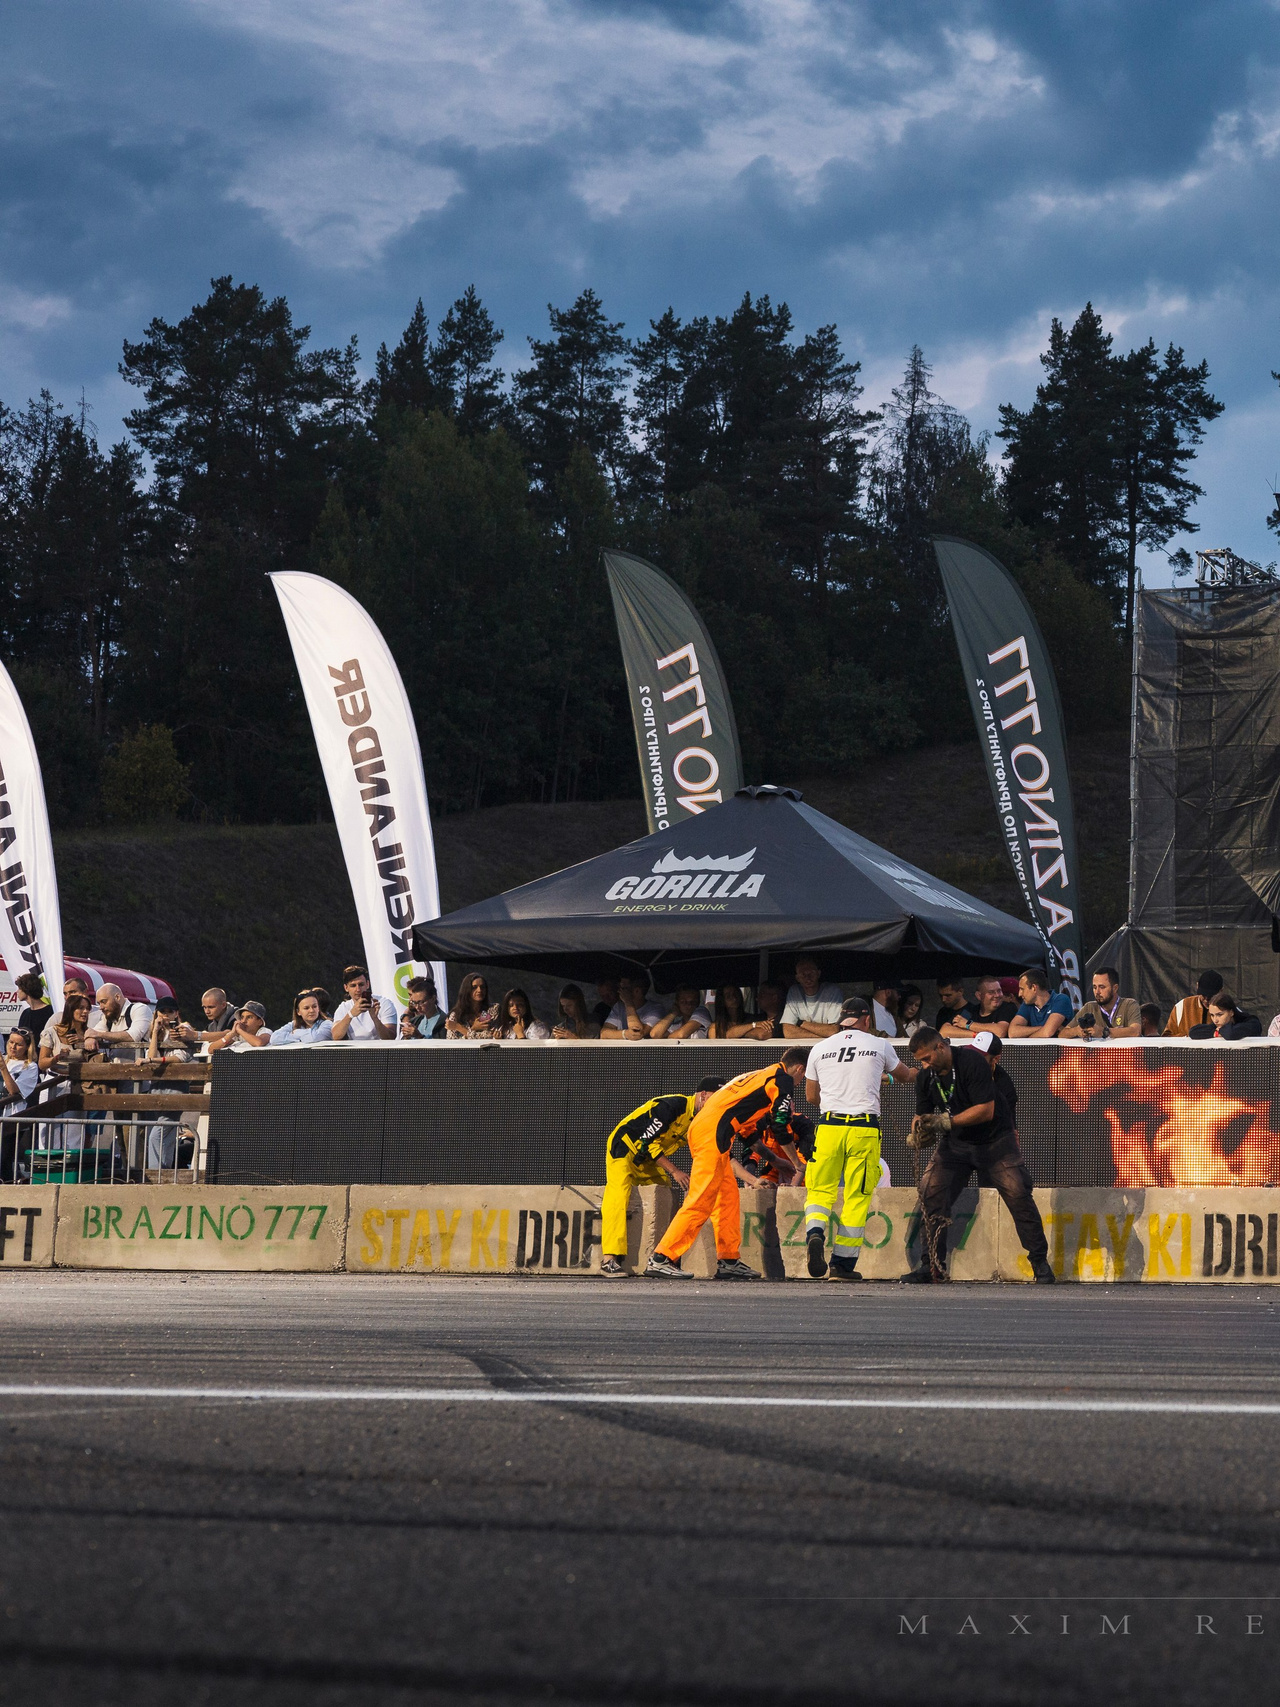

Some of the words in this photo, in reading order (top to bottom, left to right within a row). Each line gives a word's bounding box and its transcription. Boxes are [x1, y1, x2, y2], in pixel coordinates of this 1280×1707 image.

[605, 874, 766, 900] GORILLA
[613, 905, 677, 913] ENERGY
[680, 904, 729, 912] DRINK
[821, 1052, 837, 1060] AGED
[837, 1047, 857, 1062] 15
[81, 1205, 255, 1240] BRAZINO
[264, 1206, 328, 1240] 777
[360, 1208, 460, 1266] STAY
[470, 1208, 509, 1267] KI
[516, 1210, 603, 1268] DRIF
[1017, 1213, 1136, 1278] TAY
[1148, 1212, 1192, 1277] KI
